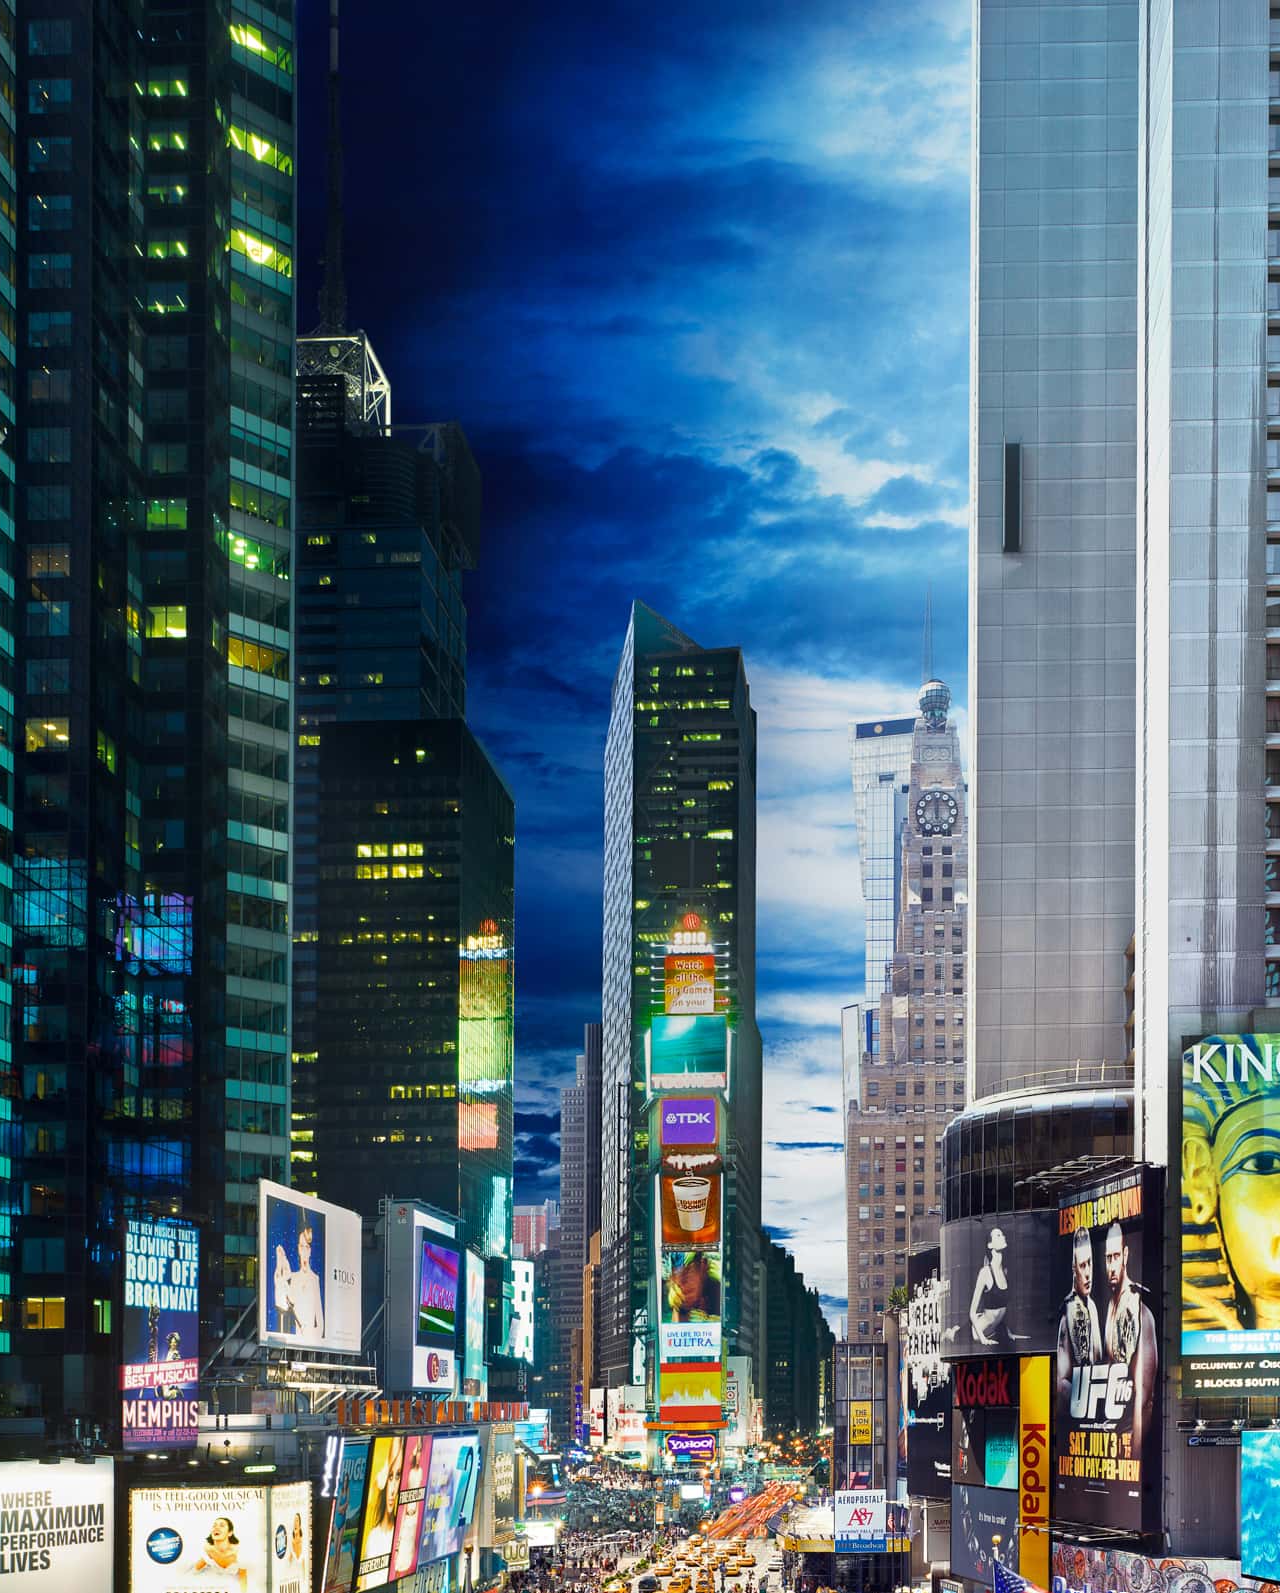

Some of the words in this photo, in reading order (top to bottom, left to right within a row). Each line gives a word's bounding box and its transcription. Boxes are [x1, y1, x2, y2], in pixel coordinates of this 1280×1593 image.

[676, 1112, 711, 1124] TDK
[126, 1233, 175, 1258] BLOWING
[126, 1254, 166, 1285] ROOF
[172, 1259, 199, 1287] OFF
[125, 1280, 198, 1312] BROADWAY!
[1190, 1361, 1242, 1371] EXCLUSIVELY
[955, 1360, 1010, 1405] Kodak
[1070, 1363, 1129, 1419] UFC
[1204, 1378, 1243, 1388] BLOCKS
[1245, 1377, 1280, 1387] SOUTH
[123, 1400, 199, 1428] MEMPHIS
[1022, 1423, 1046, 1537] Kodak
[0, 1490, 52, 1510] WHERE
[0, 1503, 105, 1534] MAXIMUM
[0, 1526, 105, 1553] PERFORMANCE
